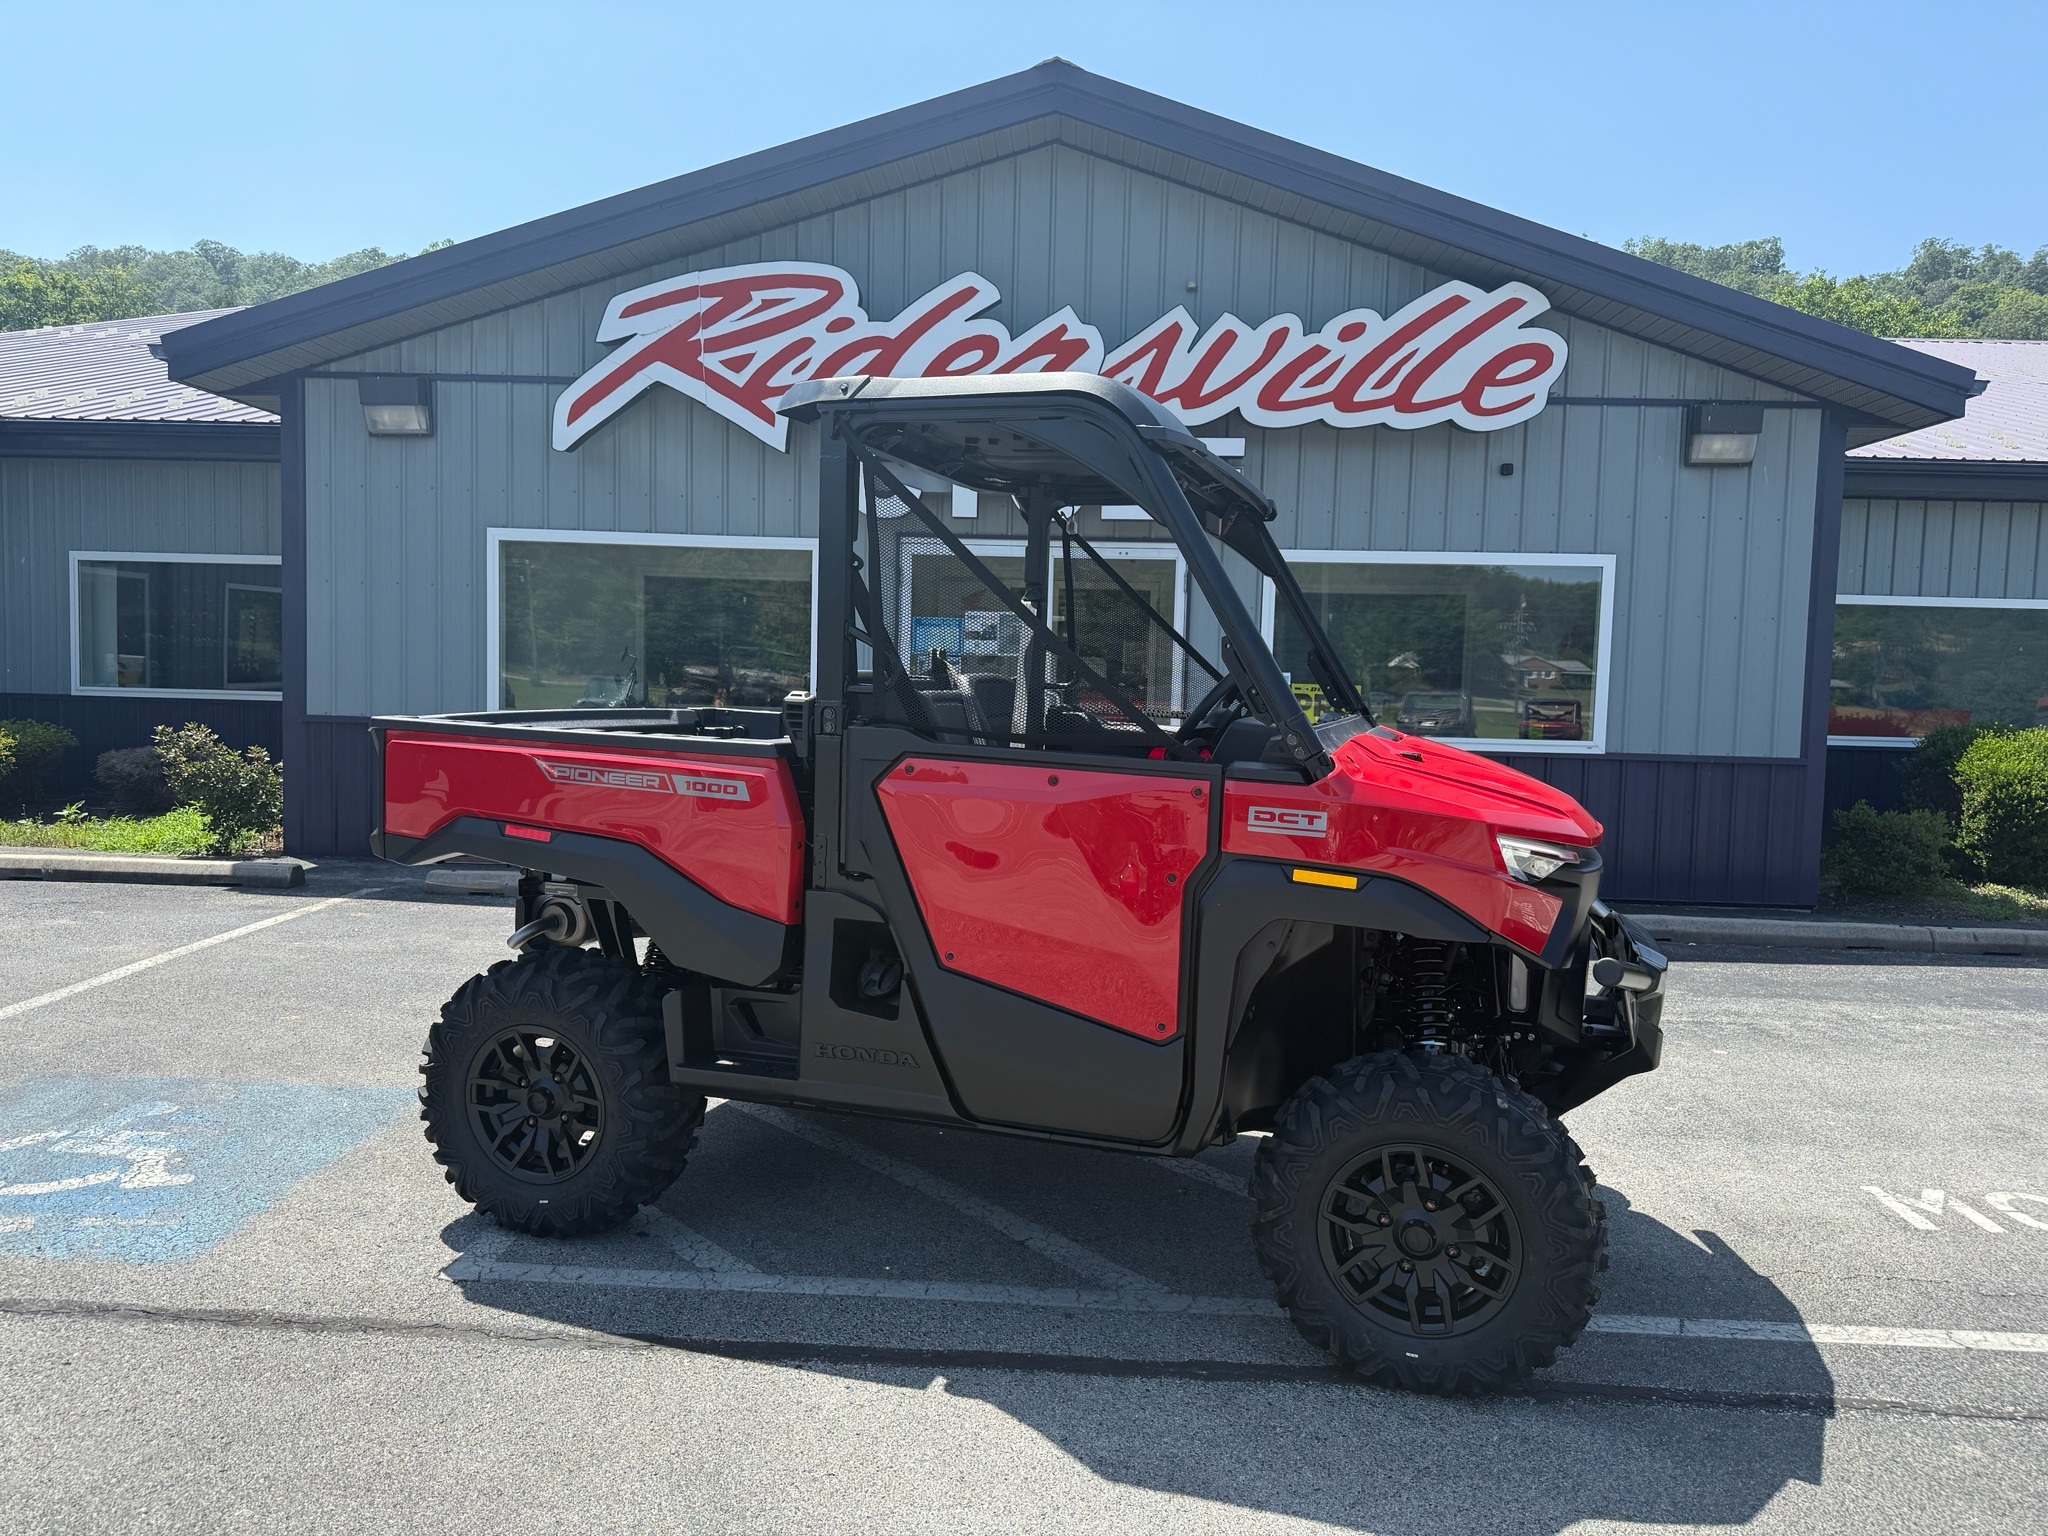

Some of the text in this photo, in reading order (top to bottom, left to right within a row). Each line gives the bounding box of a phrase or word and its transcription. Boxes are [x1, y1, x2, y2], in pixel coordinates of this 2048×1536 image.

[567, 274, 1554, 427] Ridersville
[553, 766, 739, 795] PIONEER 1000
[1253, 809, 1322, 826] DCT
[813, 1042, 920, 1069] HONDA
